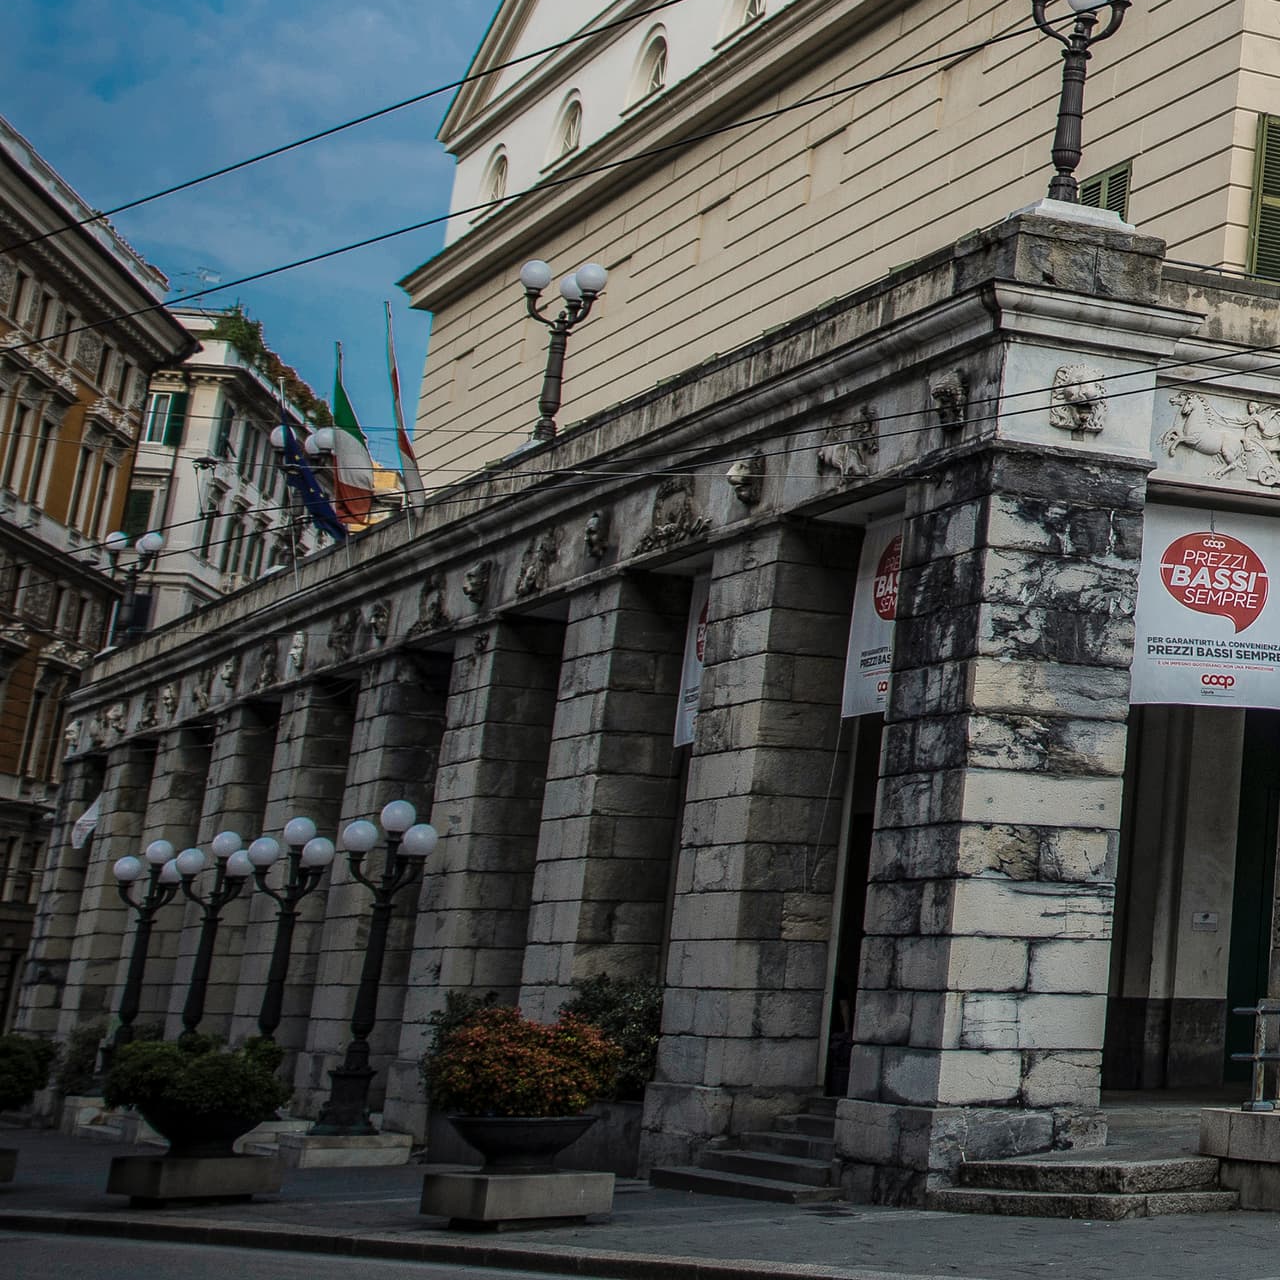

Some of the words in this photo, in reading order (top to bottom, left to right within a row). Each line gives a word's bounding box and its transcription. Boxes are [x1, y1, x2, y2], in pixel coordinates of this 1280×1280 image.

[1203, 538, 1226, 550] coop
[1183, 549, 1248, 570] PREZZI
[1170, 564, 1257, 593] BASSI
[1183, 588, 1259, 609] SEMPRE
[1147, 636, 1164, 644] PER
[1166, 638, 1214, 646] GARANTIRTI
[1216, 640, 1227, 648] LA
[1147, 645, 1193, 656] PREZZI
[1196, 647, 1232, 659] BASSI
[878, 654, 891, 665] BAS
[1201, 674, 1235, 689] coop
